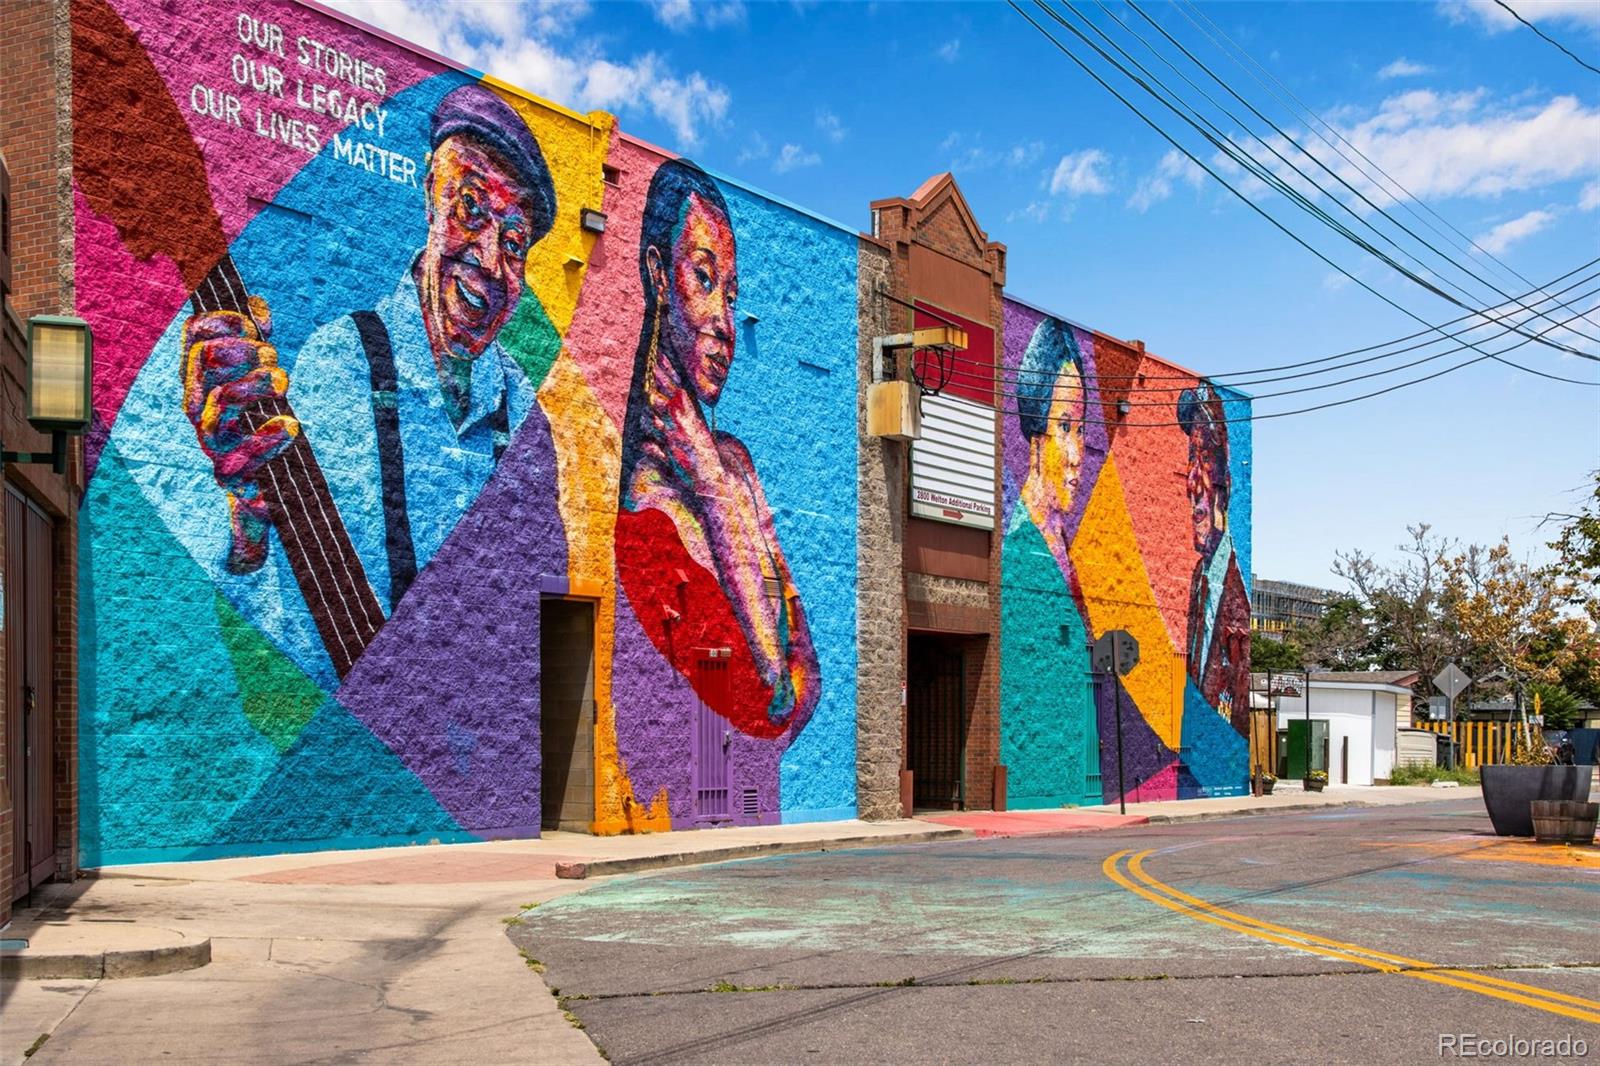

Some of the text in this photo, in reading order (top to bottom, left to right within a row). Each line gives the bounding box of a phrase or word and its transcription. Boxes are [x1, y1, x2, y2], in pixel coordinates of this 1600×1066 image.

[231, 53, 388, 137] OUR LEGACY
[238, 13, 388, 96] OUR STORIES
[191, 84, 418, 188] OUR LIVES MATTER
[917, 490, 991, 515] 2800 Welton Additional Parking
